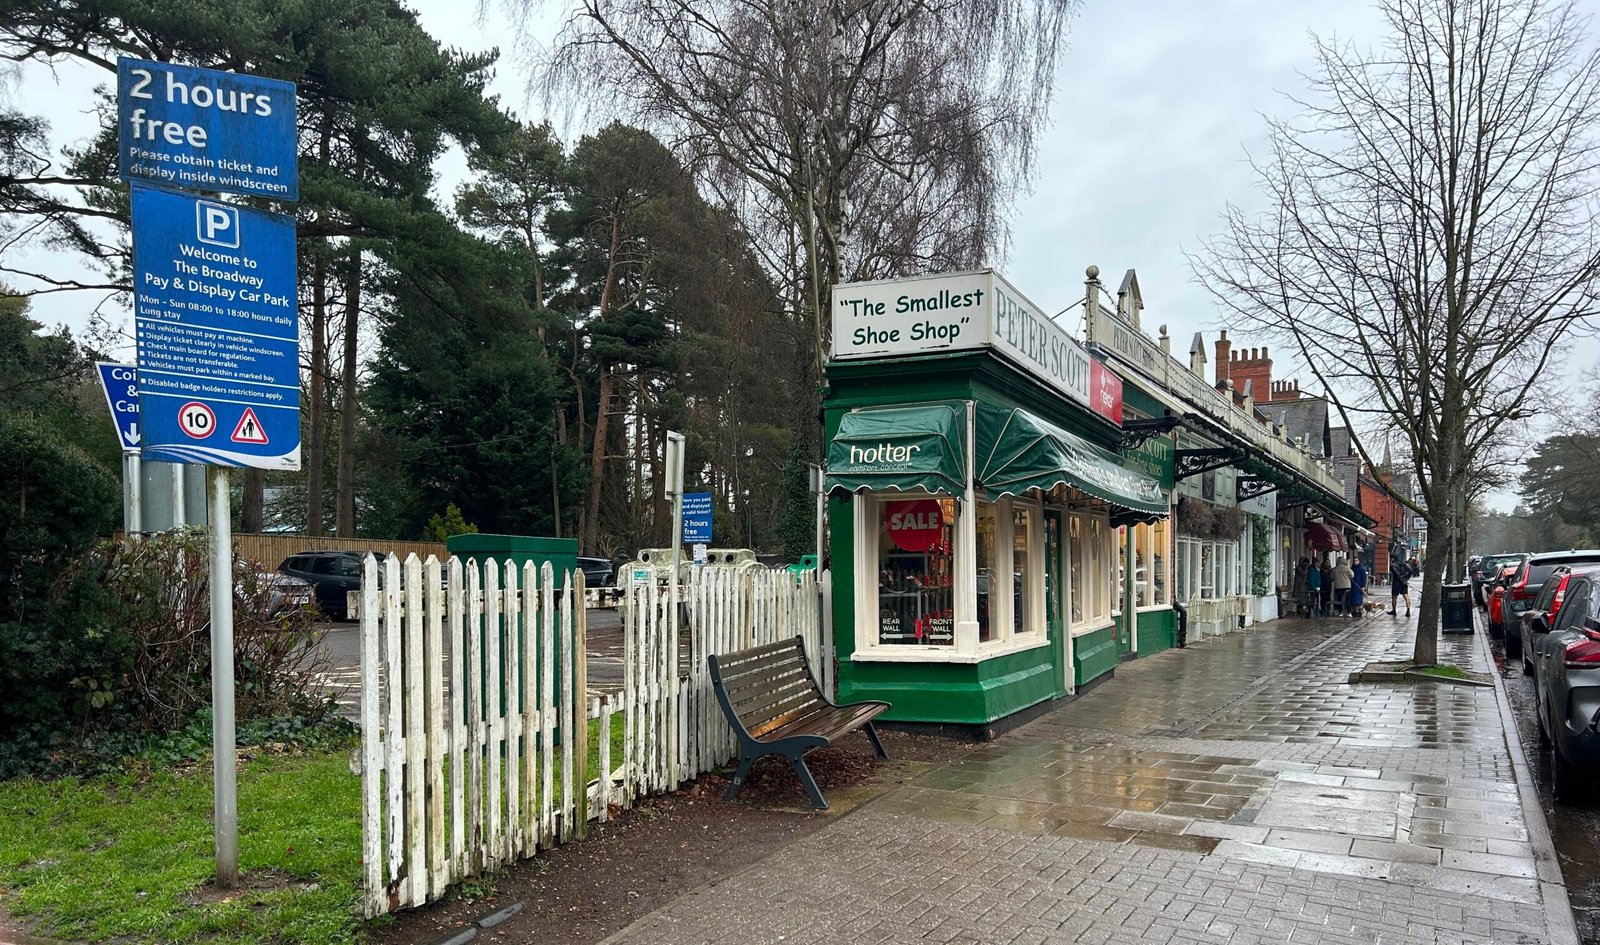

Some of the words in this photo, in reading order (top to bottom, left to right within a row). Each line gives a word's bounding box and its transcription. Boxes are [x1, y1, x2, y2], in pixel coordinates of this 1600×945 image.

[130, 69, 152, 99] 2
[166, 71, 272, 117] hours
[130, 109, 207, 148] free
[130, 147, 170, 162] Please
[174, 154, 214, 168] obtain
[218, 160, 252, 173] ticket
[257, 166, 278, 177] and
[130, 164, 176, 181] display
[180, 171, 216, 184] inside
[219, 176, 288, 193] windscreen
[207, 208, 231, 239] P
[180, 244, 240, 266] Welcome
[243, 258, 257, 269] to
[173, 260, 198, 275] The
[202, 267, 263, 289] Broadway
[145, 273, 169, 290] Pay
[173, 278, 185, 290] &
[189, 280, 236, 301] Display
[239, 290, 260, 303] Car
[264, 293, 289, 308] Park
[840, 298, 886, 317] "The
[895, 288, 984, 314] Smallest
[140, 295, 160, 305] Mon
[170, 299, 186, 309] Sun
[189, 302, 213, 313] 08:00
[215, 306, 224, 315] to
[227, 308, 250, 319] 18:00
[252, 312, 273, 324] hours
[275, 315, 293, 327] daily
[140, 306, 161, 319] Long
[163, 310, 181, 321] stay
[146, 323, 156, 331] All
[157, 324, 185, 335] vehicles
[186, 329, 203, 337] must
[204, 332, 216, 340] pay
[146, 332, 172, 343] Display
[173, 336, 193, 345] ticket
[194, 339, 216, 349] clearly
[226, 343, 248, 352] vehicle
[852, 326, 900, 346] Shoe
[910, 317, 969, 343] Shop"
[995, 287, 1047, 369] PETER
[1051, 335, 1089, 396] SCOTT
[147, 341, 168, 350] Check
[170, 345, 187, 353] main
[188, 347, 207, 356] board
[208, 349, 218, 357] for
[147, 351, 172, 360] Tickets
[148, 360, 176, 370] Vehicles
[177, 364, 194, 372] must
[196, 366, 211, 375] park
[212, 368, 232, 377] within
[239, 371, 262, 381] marked
[127, 385, 139, 396] &
[148, 378, 179, 388] Disabled
[180, 381, 201, 392] badge
[202, 384, 227, 394] holders
[228, 387, 264, 398] restrictions
[265, 391, 284, 401] apply.
[186, 412, 208, 428] 10
[850, 443, 920, 464] hotter
[1145, 437, 1167, 461] SCOTT
[891, 512, 939, 530] SALE
